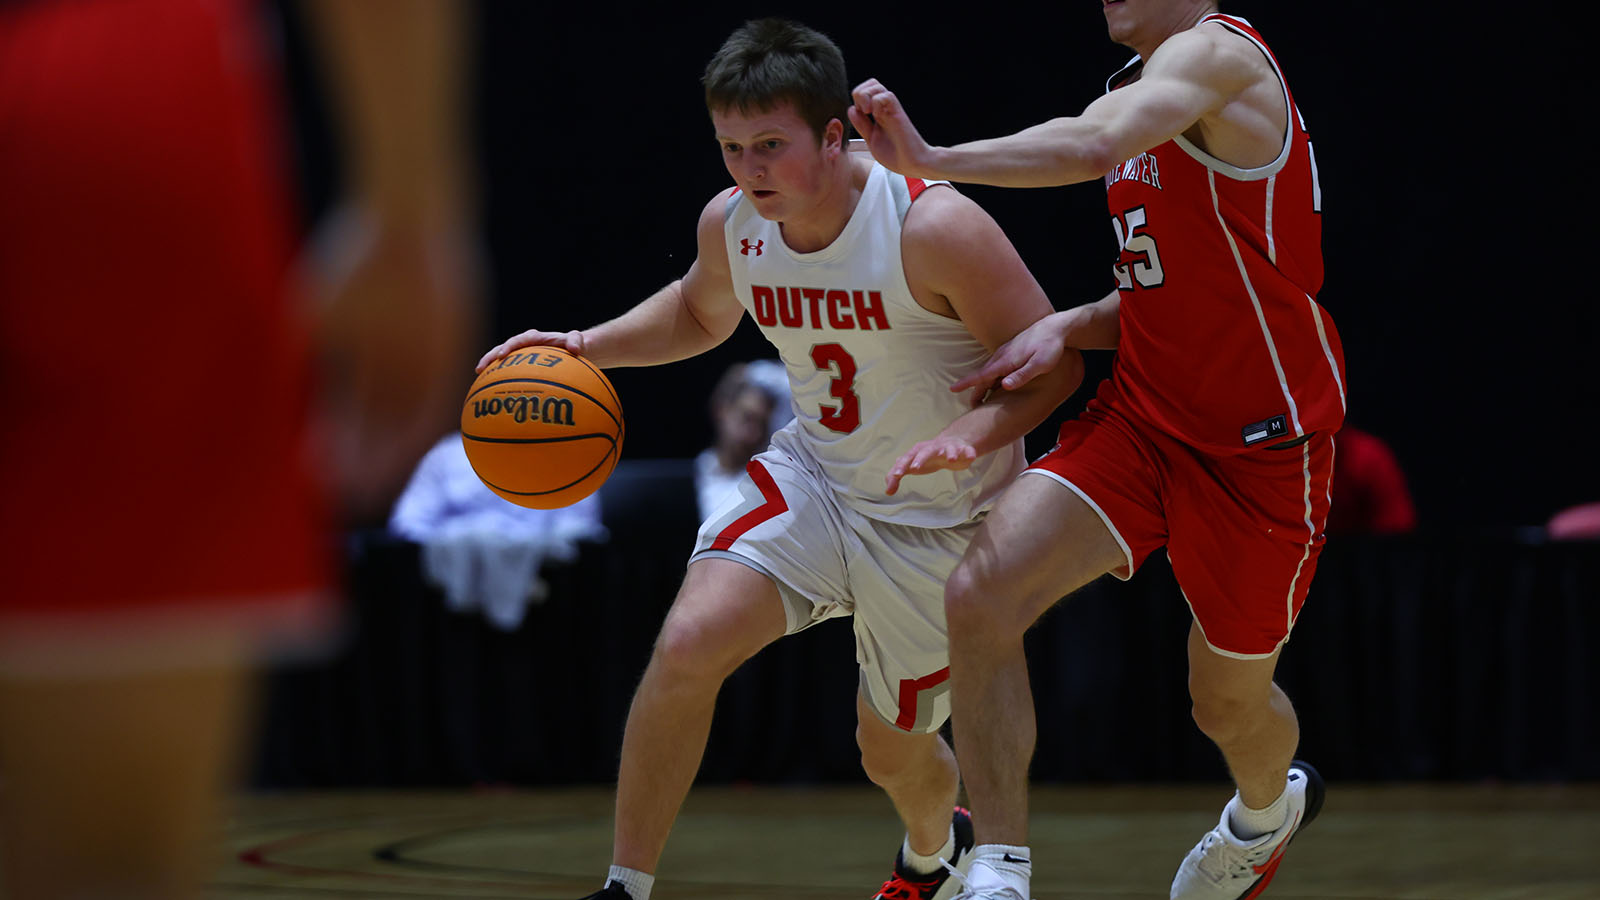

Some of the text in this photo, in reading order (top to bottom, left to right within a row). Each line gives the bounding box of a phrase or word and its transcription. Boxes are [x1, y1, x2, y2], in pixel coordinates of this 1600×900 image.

[751, 284, 892, 331] DUTCH
[809, 342, 862, 435] 3
[473, 395, 576, 427] Wilson
[1271, 420, 1281, 431] M
